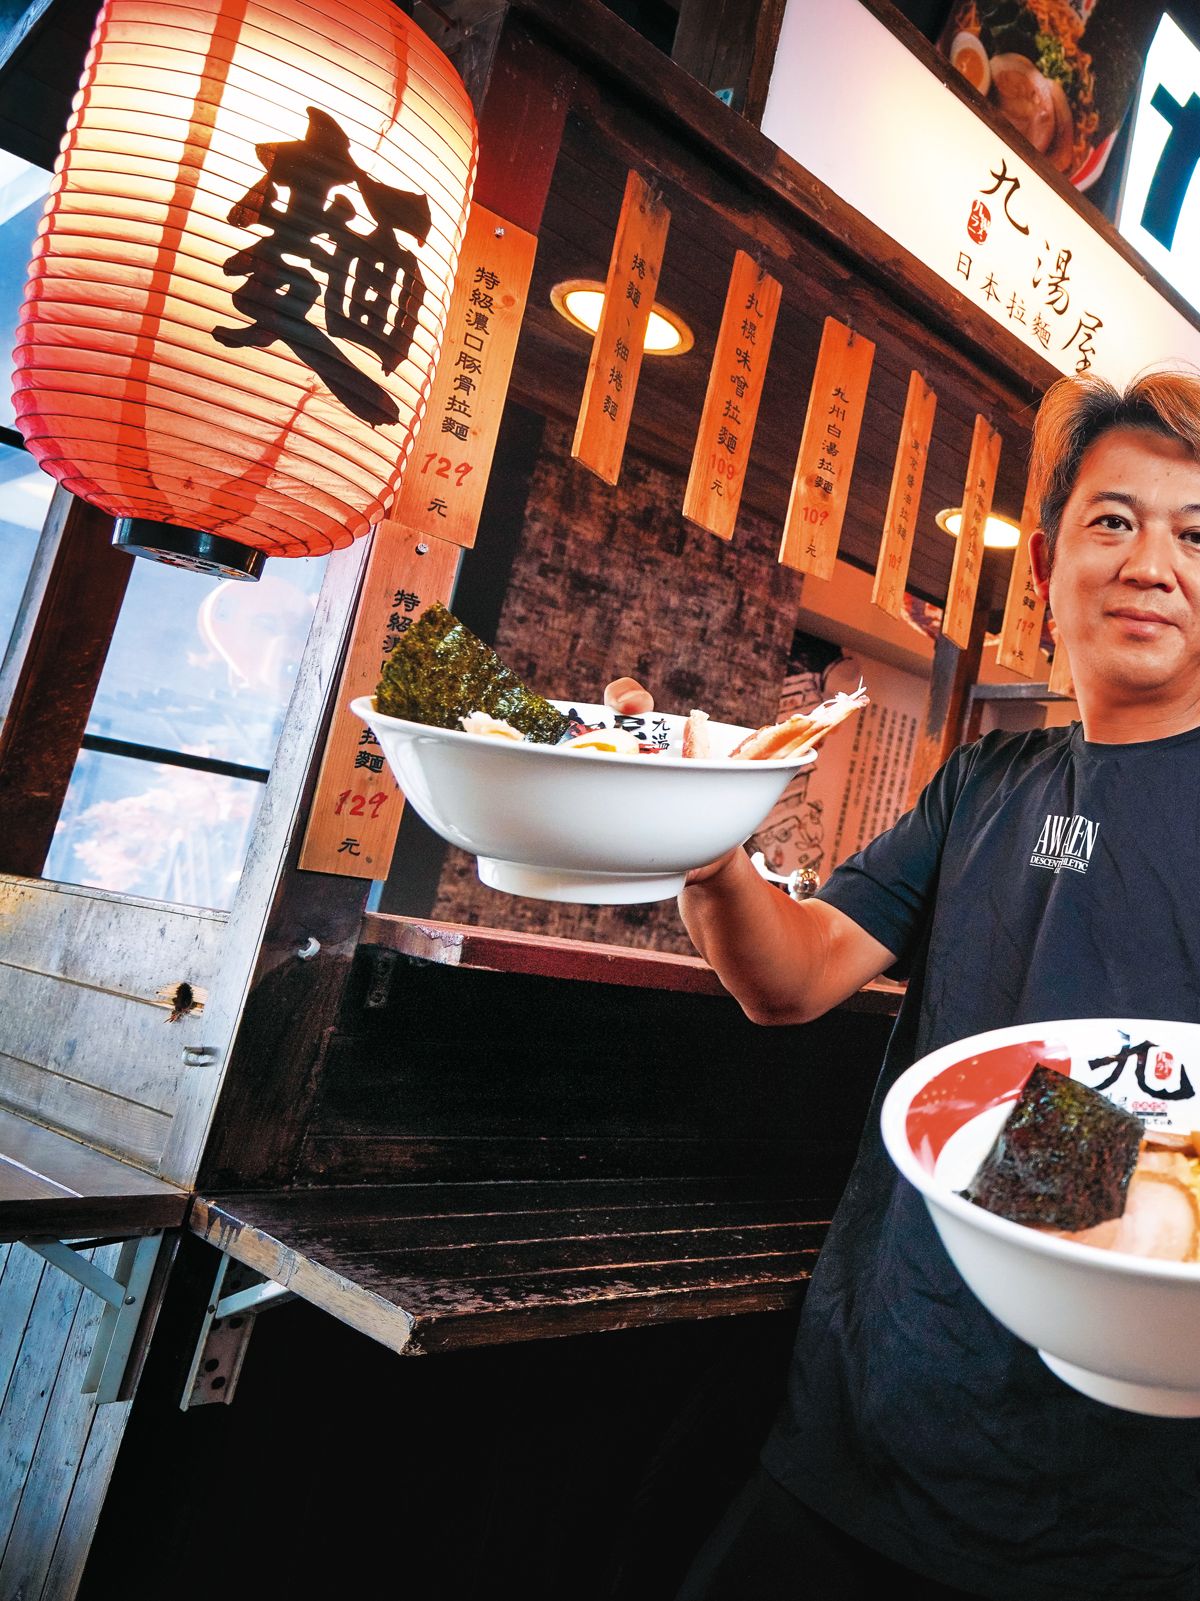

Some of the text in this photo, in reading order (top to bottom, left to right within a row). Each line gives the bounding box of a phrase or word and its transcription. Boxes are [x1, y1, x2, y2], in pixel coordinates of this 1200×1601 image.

[956, 250, 1051, 350] 日本拉麵
[980, 158, 1104, 373] 九湯屋
[420, 266, 501, 518] 特級濃口豚骨拉麵 129 元
[814, 386, 849, 494] 九州白湯拉麵
[710, 453, 736, 481] 109
[334, 789, 388, 820] 129
[337, 838, 361, 857] 元
